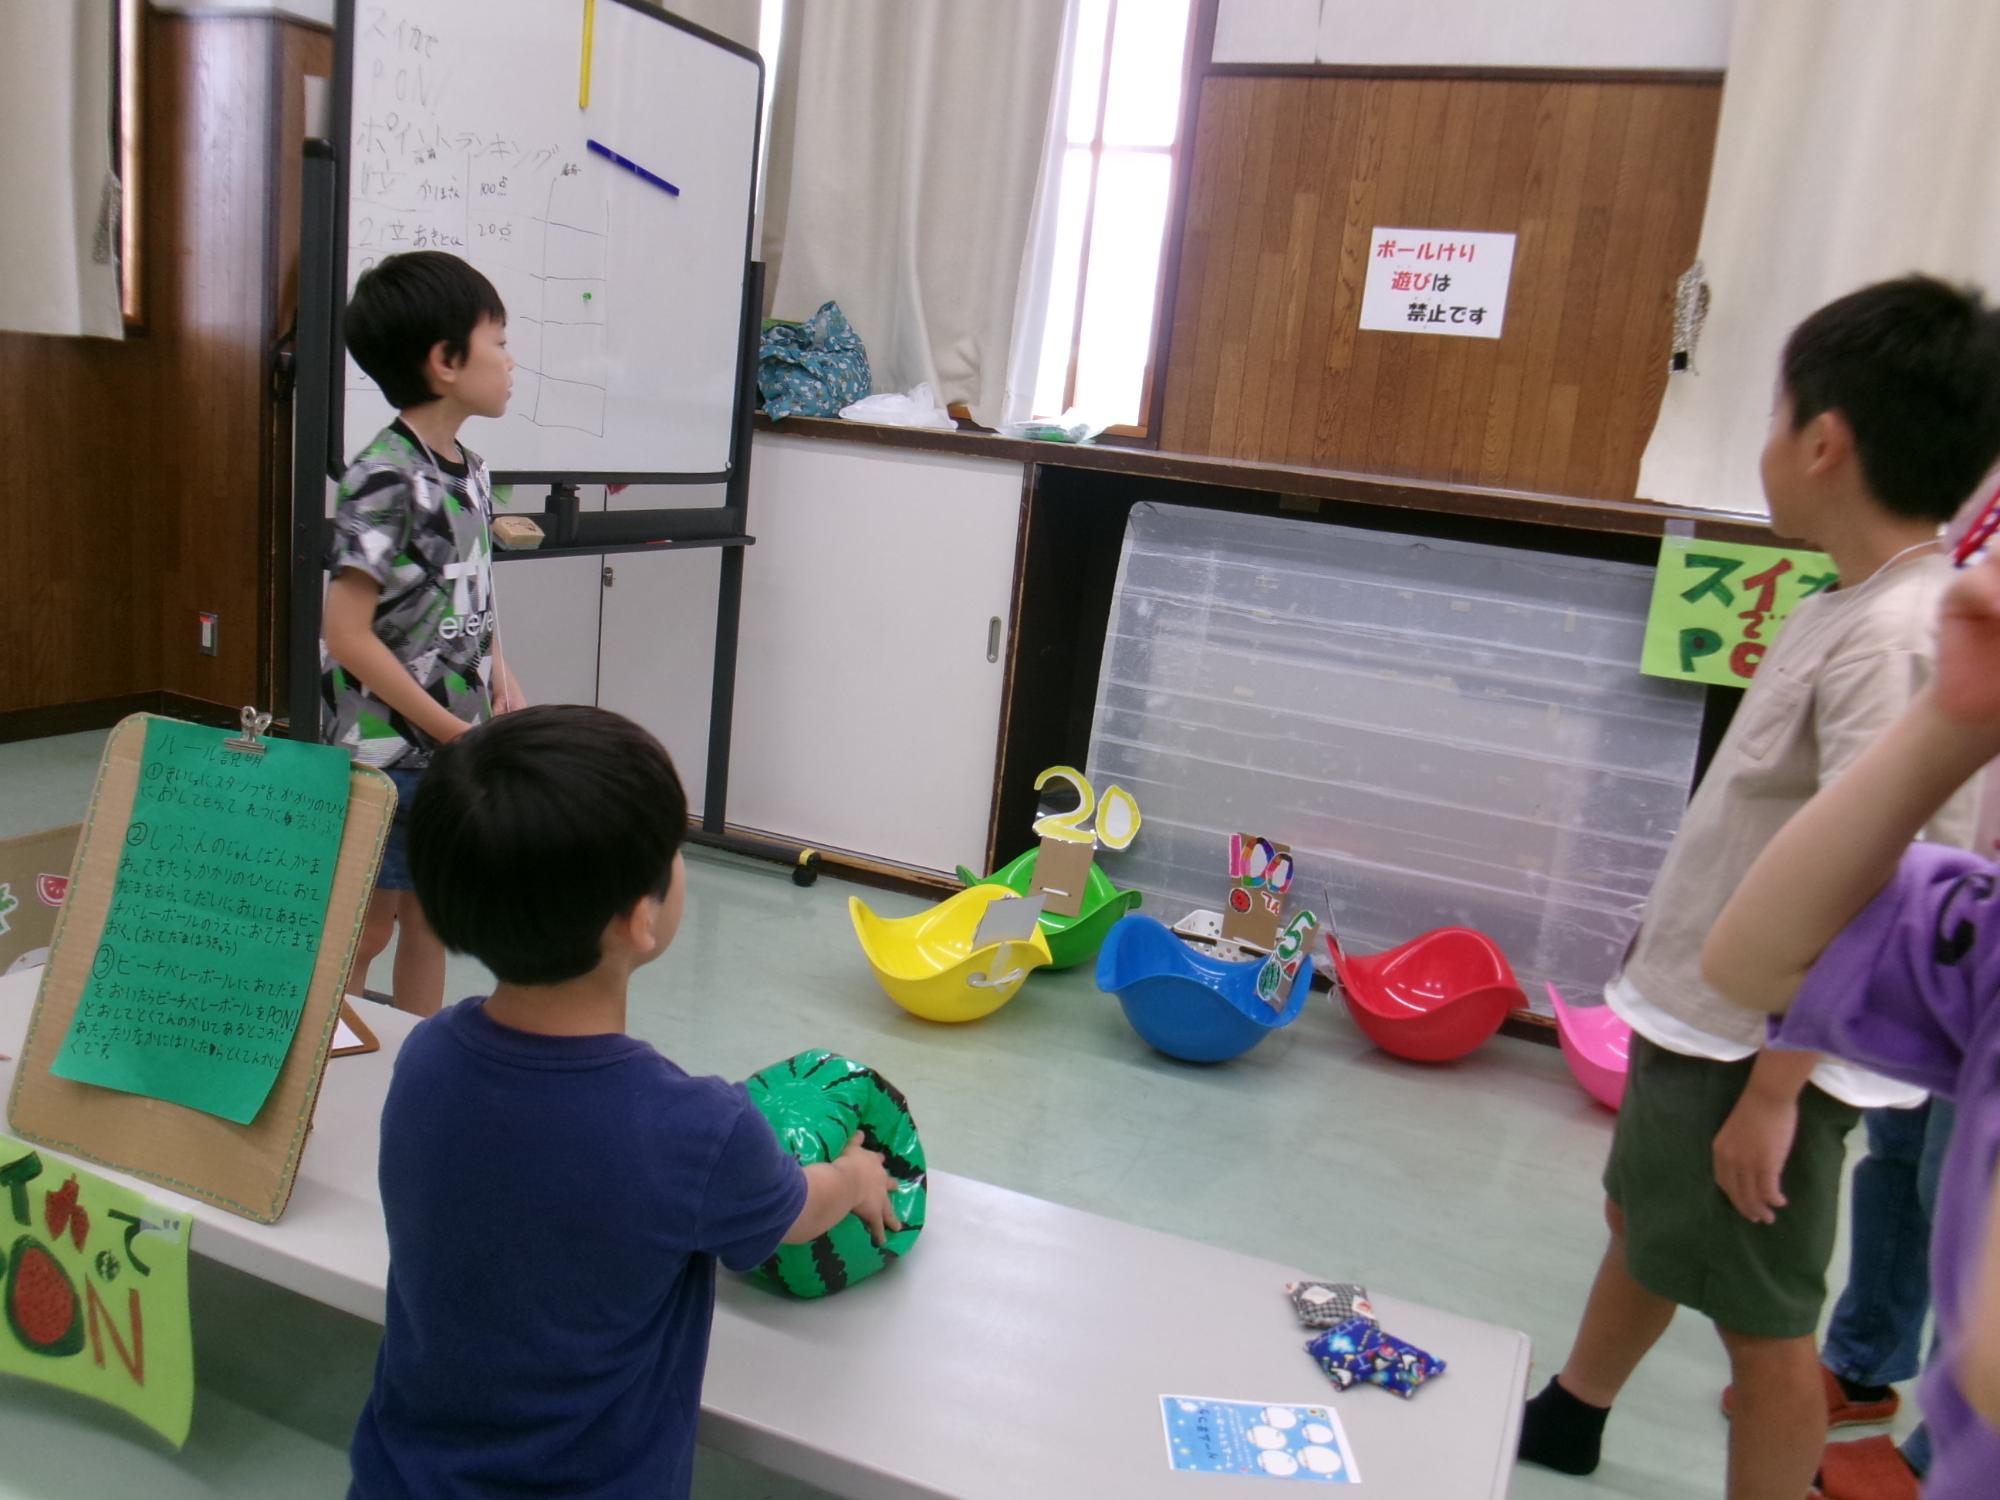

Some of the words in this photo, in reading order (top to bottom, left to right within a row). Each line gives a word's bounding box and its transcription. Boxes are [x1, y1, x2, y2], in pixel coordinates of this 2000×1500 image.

[1376, 240, 1476, 262] ボールけり
[1391, 271, 1451, 292] 遊びは
[1407, 302, 1487, 325] 禁止です
[156, 733, 264, 768] ルール説明
[1033, 765, 1141, 849] 20
[1229, 834, 1294, 893] 100
[1277, 910, 1318, 962] 5
